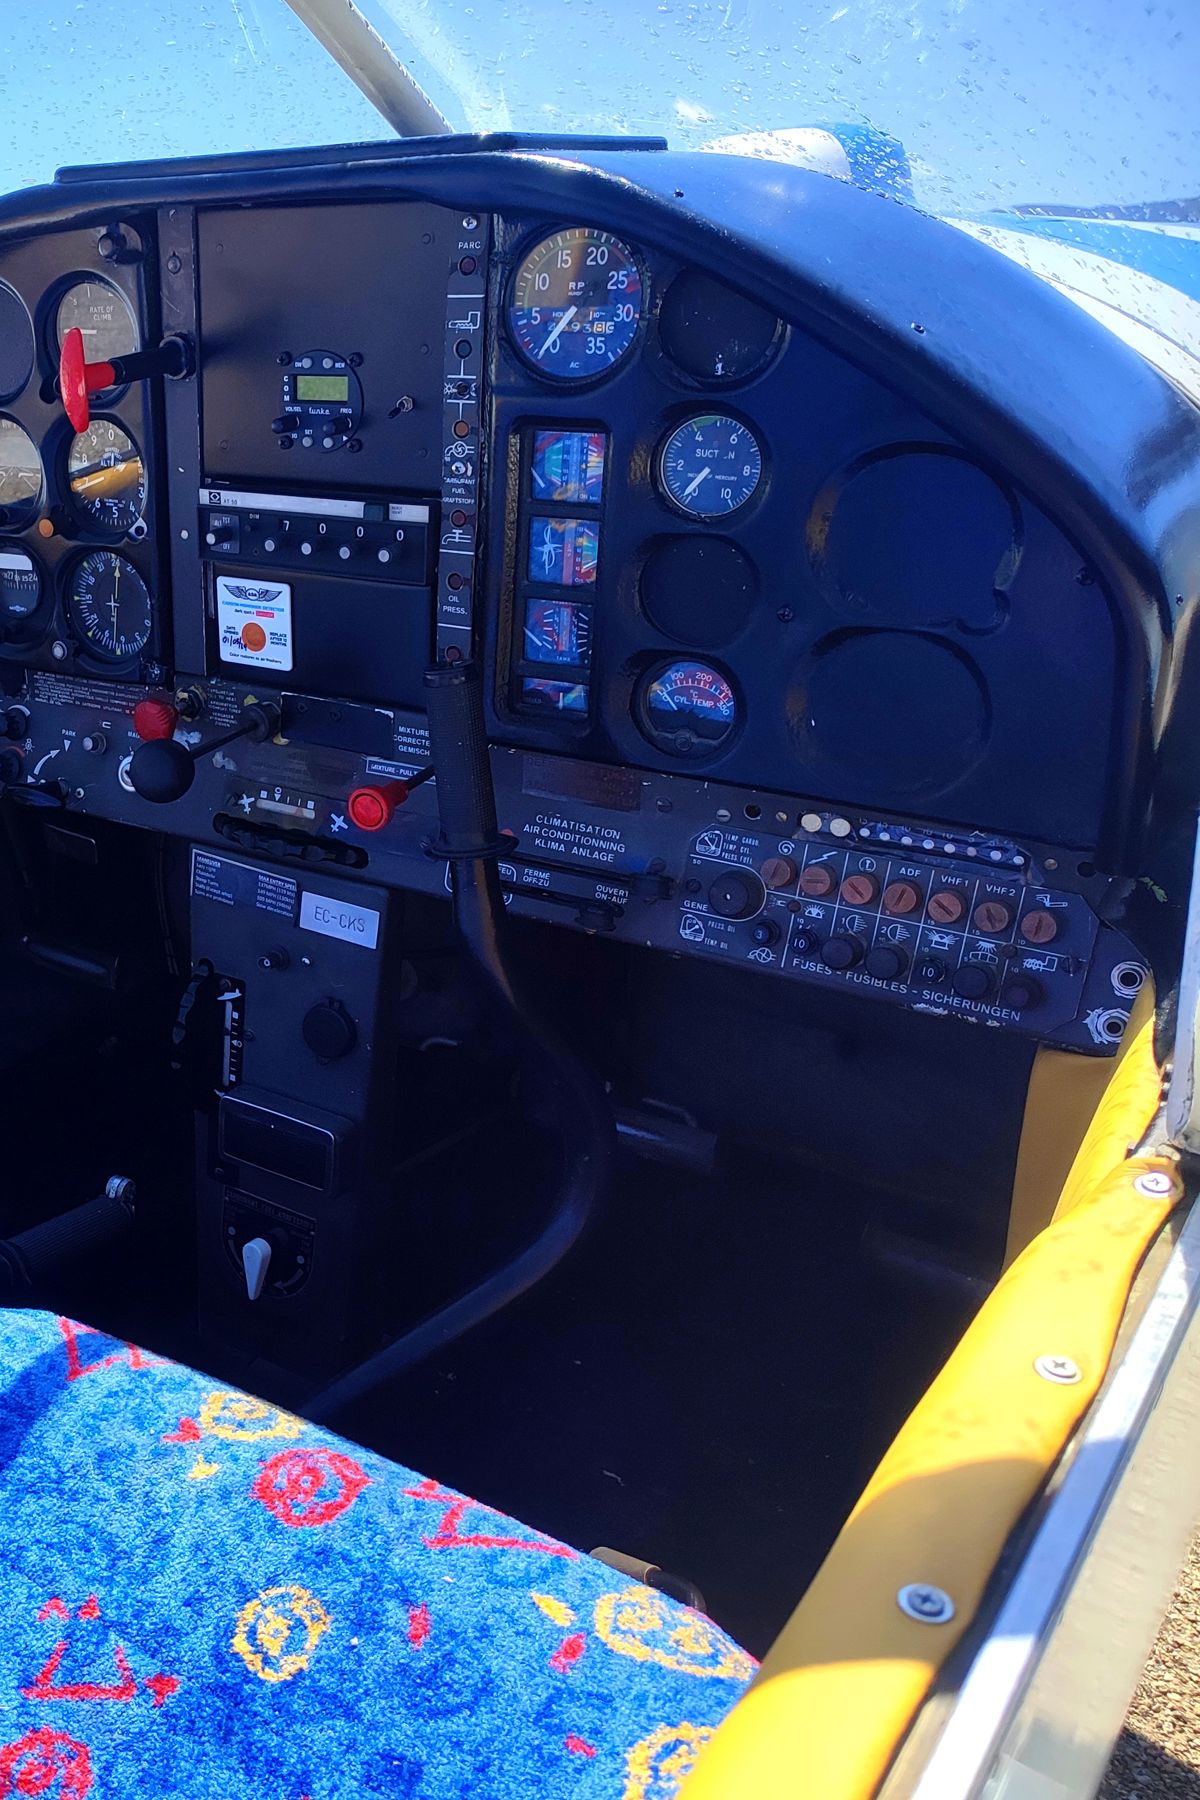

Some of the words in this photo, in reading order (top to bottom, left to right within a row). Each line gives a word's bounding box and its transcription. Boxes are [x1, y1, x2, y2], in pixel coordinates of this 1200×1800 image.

[458, 241, 481, 249] PARC
[557, 250, 571, 268] 15
[586, 247, 608, 265] 20
[535, 273, 549, 290] 10
[607, 271, 627, 290] 25
[531, 307, 540, 324] 5
[613, 304, 633, 322] 30
[585, 337, 605, 354] 35
[91, 435, 97, 446] 9
[108, 429, 114, 440] 0
[695, 431, 704, 442] 4
[729, 433, 738, 444] 6
[82, 453, 88, 464] 8
[695, 448, 735, 460] SUCTN
[676, 459, 684, 471] 2
[743, 465, 751, 476] 8
[138, 487, 144, 498] 3
[720, 488, 732, 499] 10
[94, 497, 101, 508] 6
[129, 501, 135, 513] 4
[112, 507, 119, 518] 5
[283, 520, 290, 531] 7
[319, 522, 326, 534] 0
[356, 526, 364, 538] 0
[396, 529, 404, 542] 0
[442, 605, 468, 615] PRESS.
[670, 672, 684, 681] 100
[695, 672, 712, 682] 200
[692, 698, 715, 709] TEMP.
[717, 700, 730, 716] 350
[61, 729, 77, 737] PARK
[398, 725, 430, 738] MIXTURE
[393, 734, 431, 747] CORRECTE
[398, 745, 430, 756] GEMISCH
[371, 763, 396, 774] MIXTURE
[399, 768, 413, 777] PULL
[535, 814, 621, 840] CLIMATISATION
[522, 823, 540, 836] AIR
[541, 828, 626, 853] CONDITIONNING
[534, 838, 565, 853] KLIMA
[571, 846, 615, 863] ANLAGE
[899, 867, 921, 877] ADF
[522, 875, 550, 887] OFF-ZU
[940, 874, 963, 886] VHF
[964, 879, 969, 888] 1
[985, 883, 1007, 895] VHF
[1006, 888, 1016, 897] 2
[595, 892, 629, 905] ON-AUF
[683, 899, 709, 912] GENE
[314, 906, 365, 933] EC-CKS
[841, 917, 846, 925] 1
[757, 930, 763, 939] 3
[881, 926, 887, 934] 2
[793, 938, 806, 949] 10
[921, 966, 935, 978] 10
[792, 957, 833, 975] FUSES
[845, 970, 908, 991] FUSIBLES
[921, 990, 1021, 1022] SICHERUNGEN
